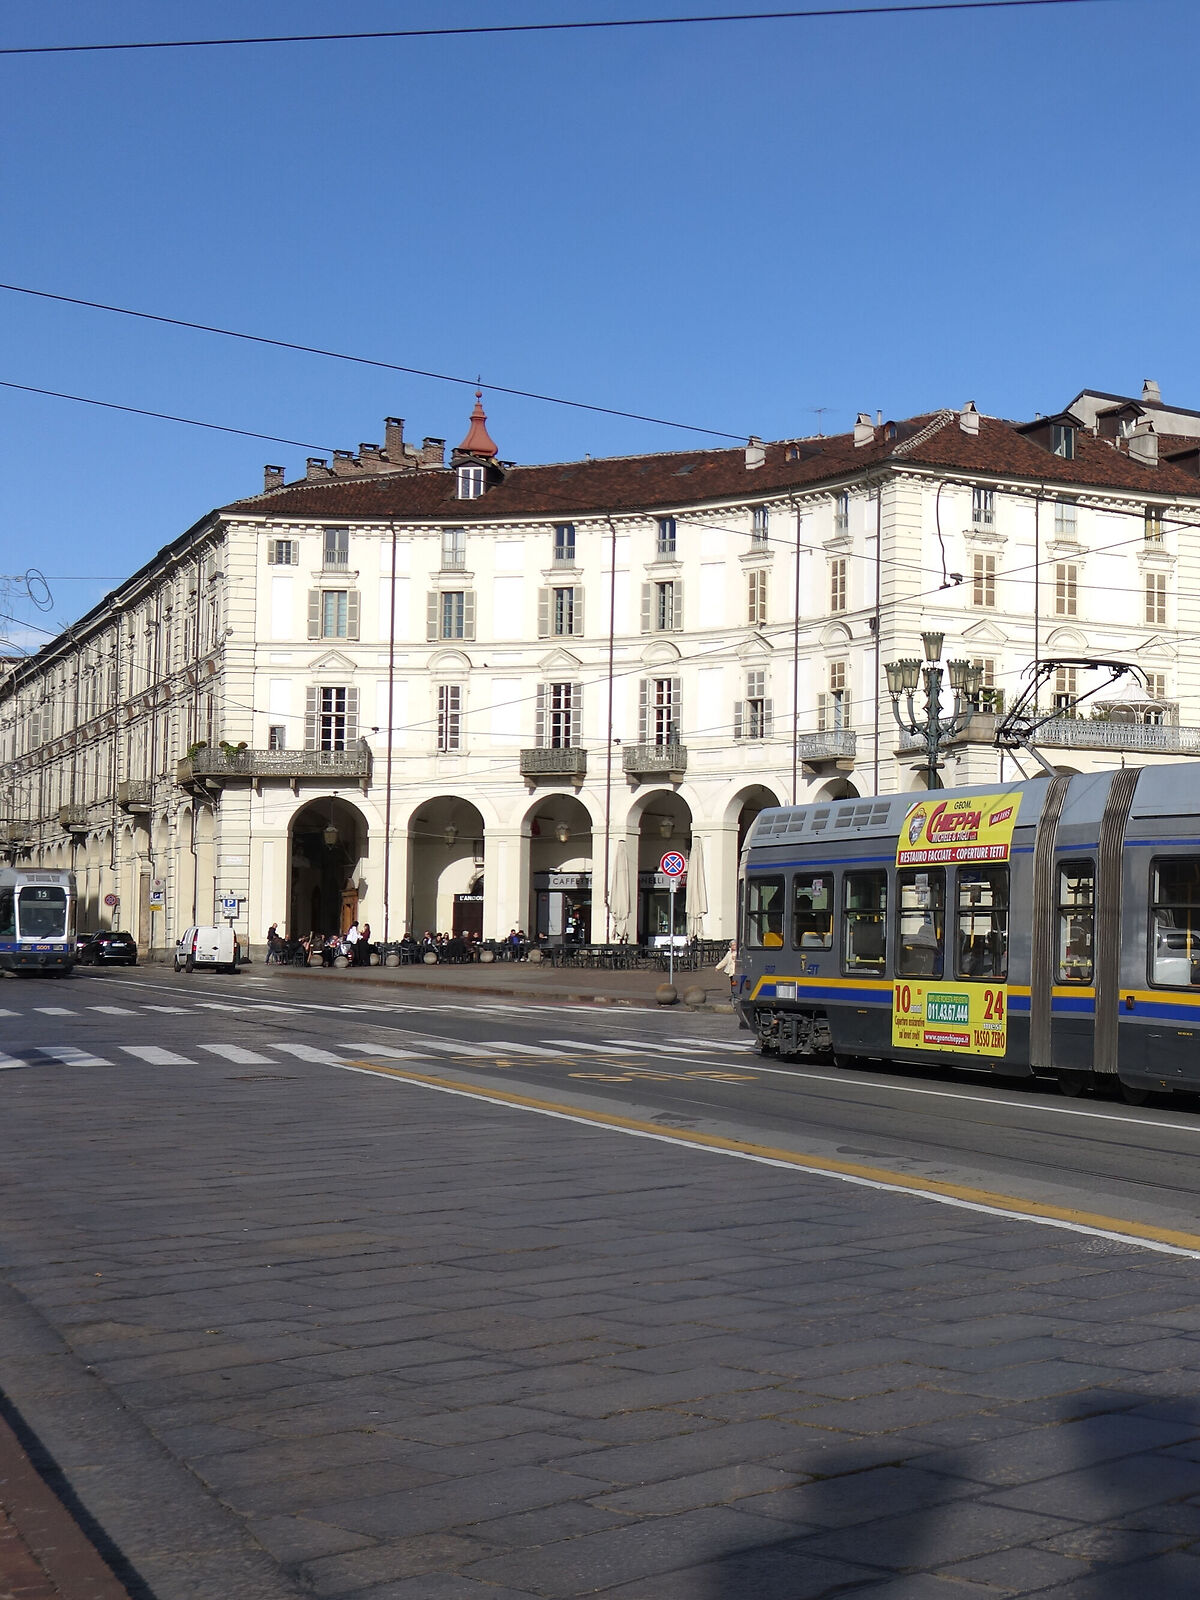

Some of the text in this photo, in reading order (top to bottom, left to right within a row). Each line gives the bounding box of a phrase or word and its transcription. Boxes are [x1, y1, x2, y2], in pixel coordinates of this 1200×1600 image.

[926, 802, 982, 843] CHIEPPA
[932, 833, 952, 842] MICHELE
[952, 833, 956, 841] &
[957, 832, 969, 840] FIGLI
[900, 850, 927, 863] RESTAURO
[928, 849, 952, 861] FACCIATE
[956, 847, 988, 859] COPERTURE
[989, 846, 1005, 857] TETTI
[895, 985, 911, 1013] 10
[984, 990, 1004, 1020] 24
[928, 1003, 968, 1022] 011.43.67.444
[983, 1021, 1002, 1031] mesi
[974, 1030, 1004, 1048] TASSO ZERO
